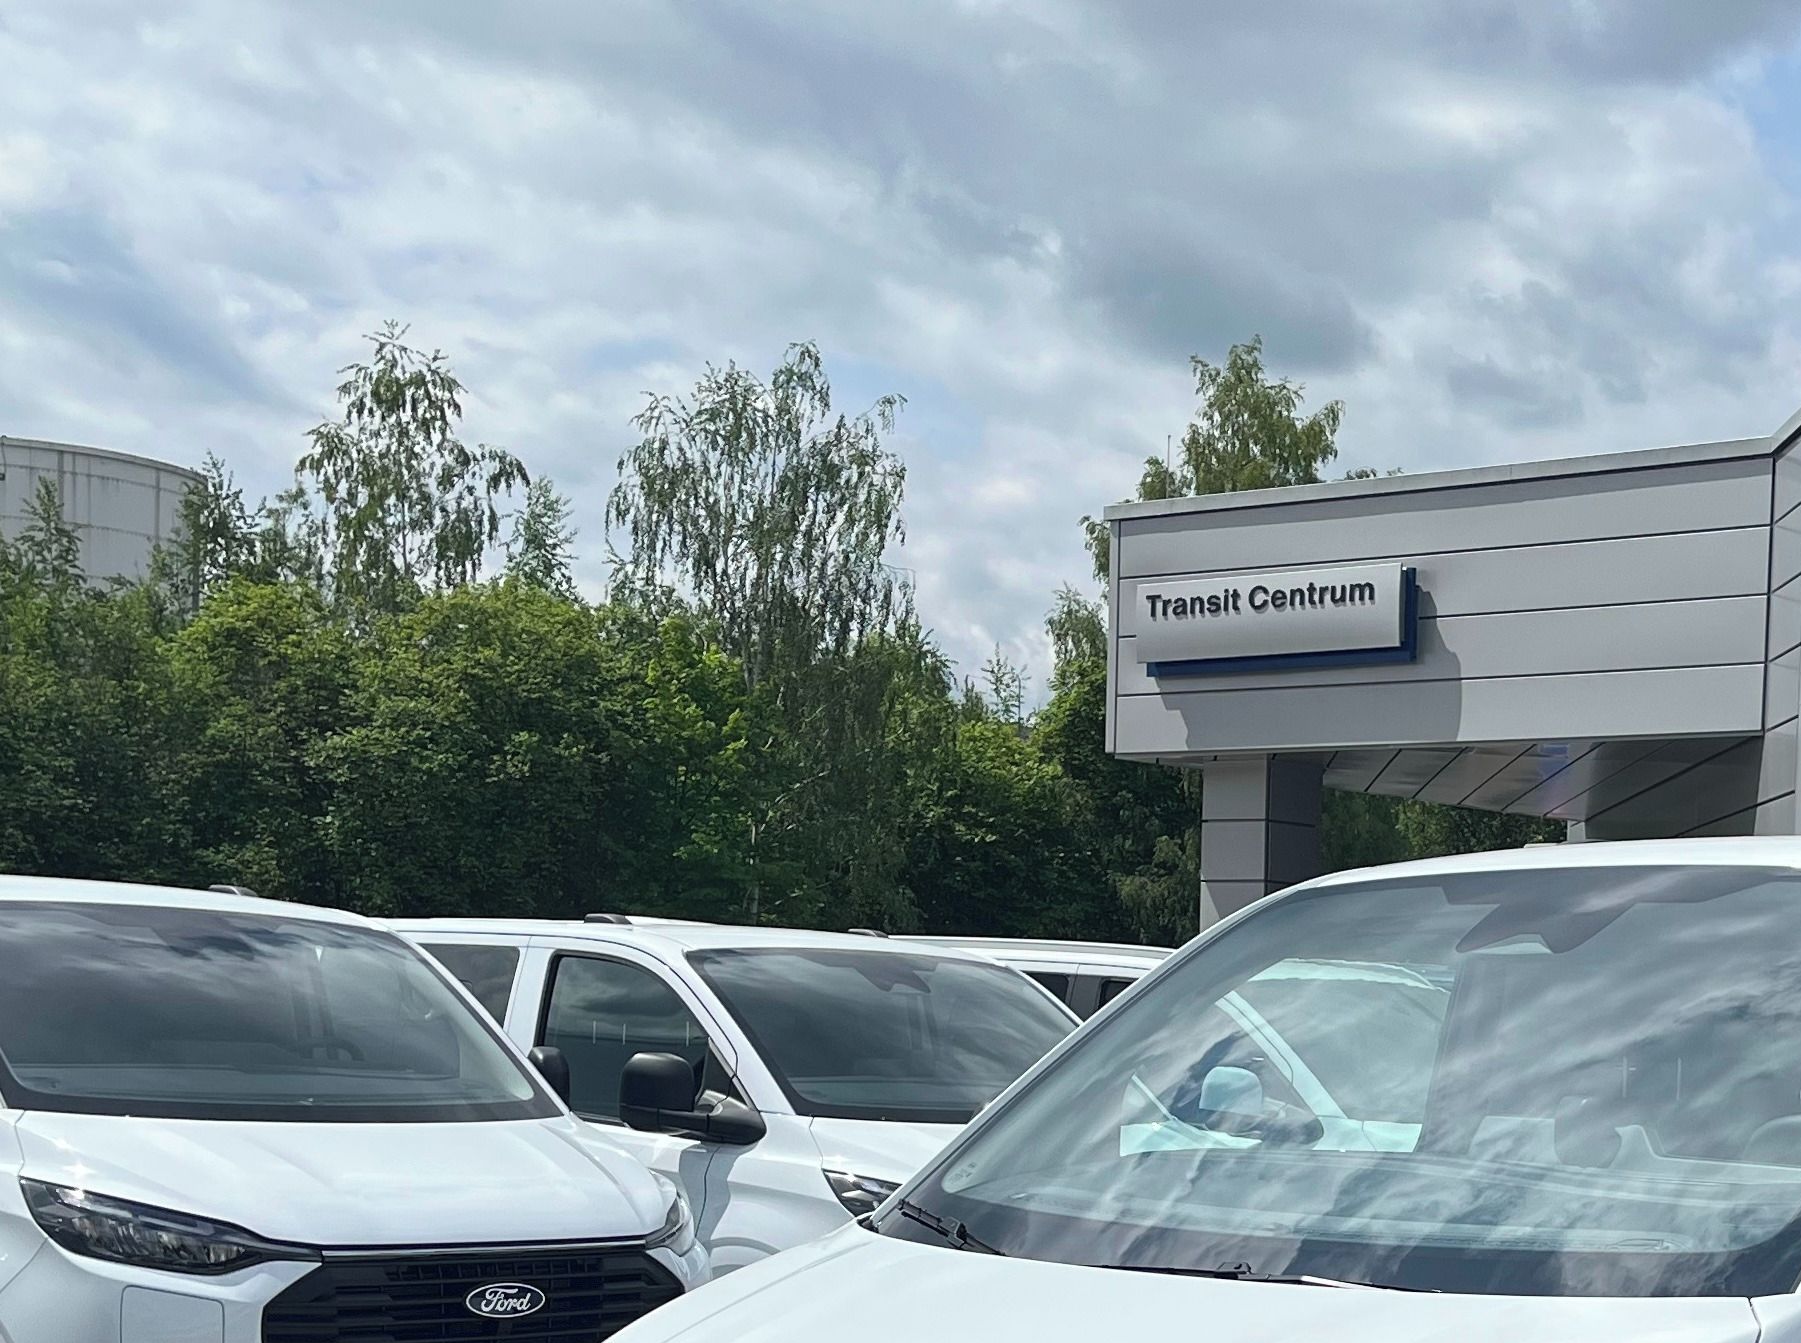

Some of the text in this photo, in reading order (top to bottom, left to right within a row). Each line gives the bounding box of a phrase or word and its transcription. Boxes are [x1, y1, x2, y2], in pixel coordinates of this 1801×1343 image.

[1146, 581, 1375, 619] Transit Centrum
[481, 1288, 531, 1312] Ford
